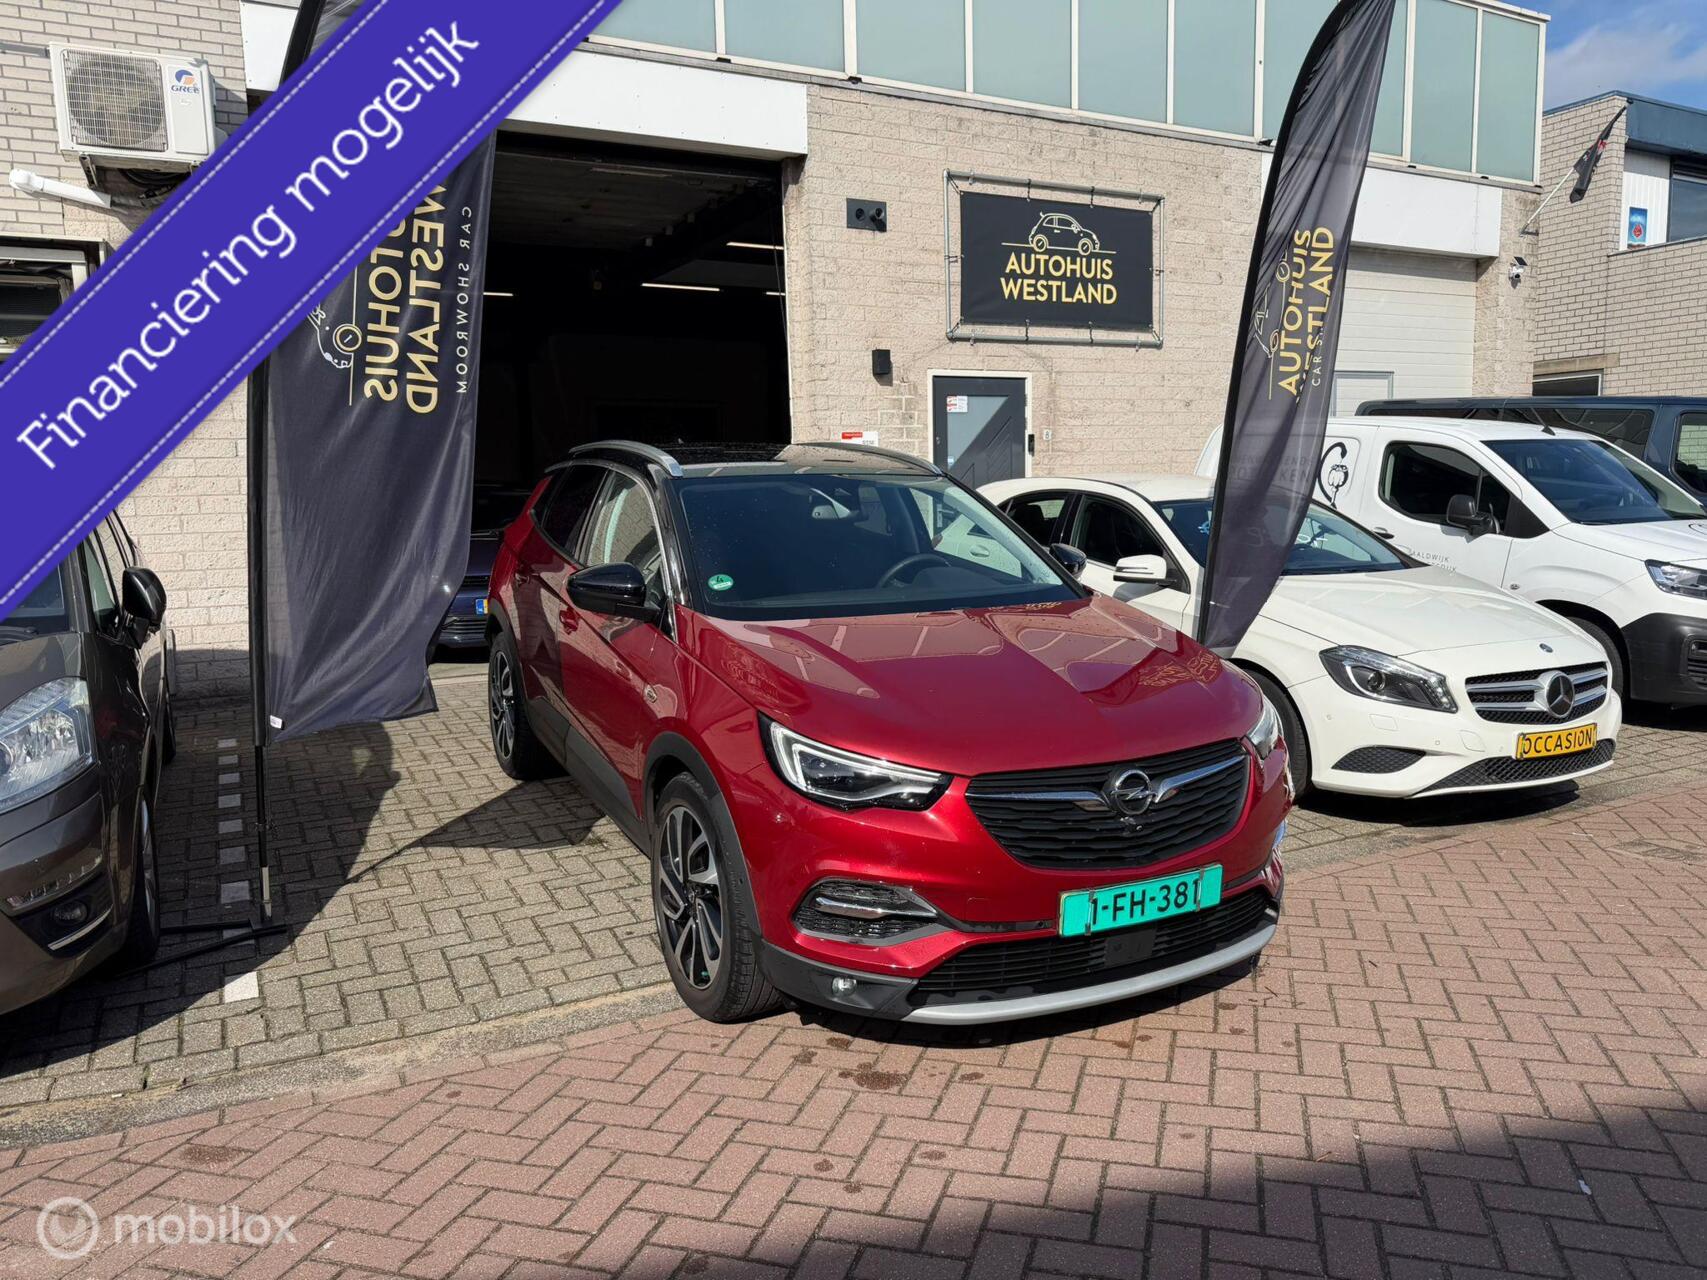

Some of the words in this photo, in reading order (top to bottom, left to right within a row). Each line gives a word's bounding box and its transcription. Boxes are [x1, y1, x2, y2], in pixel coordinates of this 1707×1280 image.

[1005, 252, 1113, 280] AUTOHUIS
[1000, 278, 1118, 305] WESTLAND
[1277, 229, 1311, 396] AUTOHUIS
[1311, 355, 1323, 386] CAR
[1522, 727, 1593, 755] OCCASION
[1090, 878, 1201, 925] 1-FH-381
